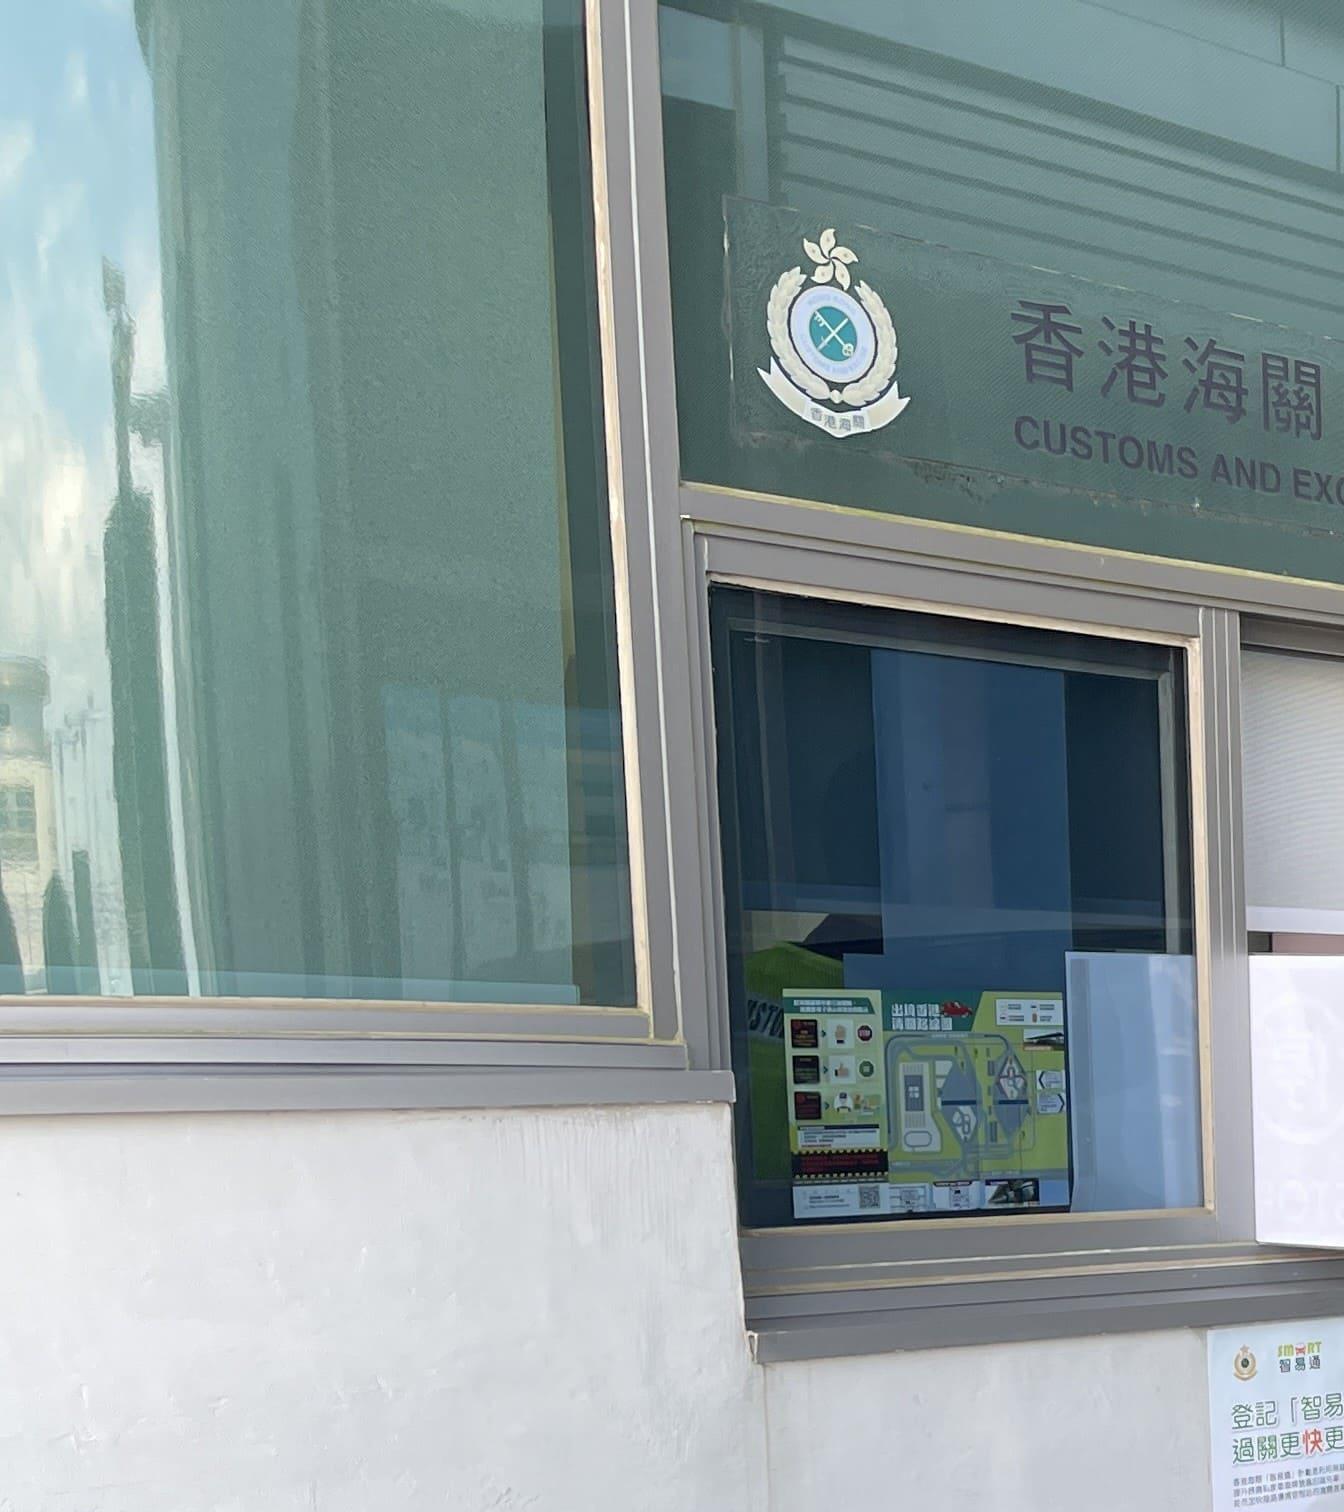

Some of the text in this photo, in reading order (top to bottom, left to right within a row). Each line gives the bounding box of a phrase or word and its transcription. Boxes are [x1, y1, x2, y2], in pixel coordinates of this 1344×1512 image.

[1010, 299, 1322, 441] 香港海關
[1014, 415, 1199, 479] CUSTOMS
[1211, 453, 1281, 493] AND
[1279, 1355, 1321, 1373] 智易通
